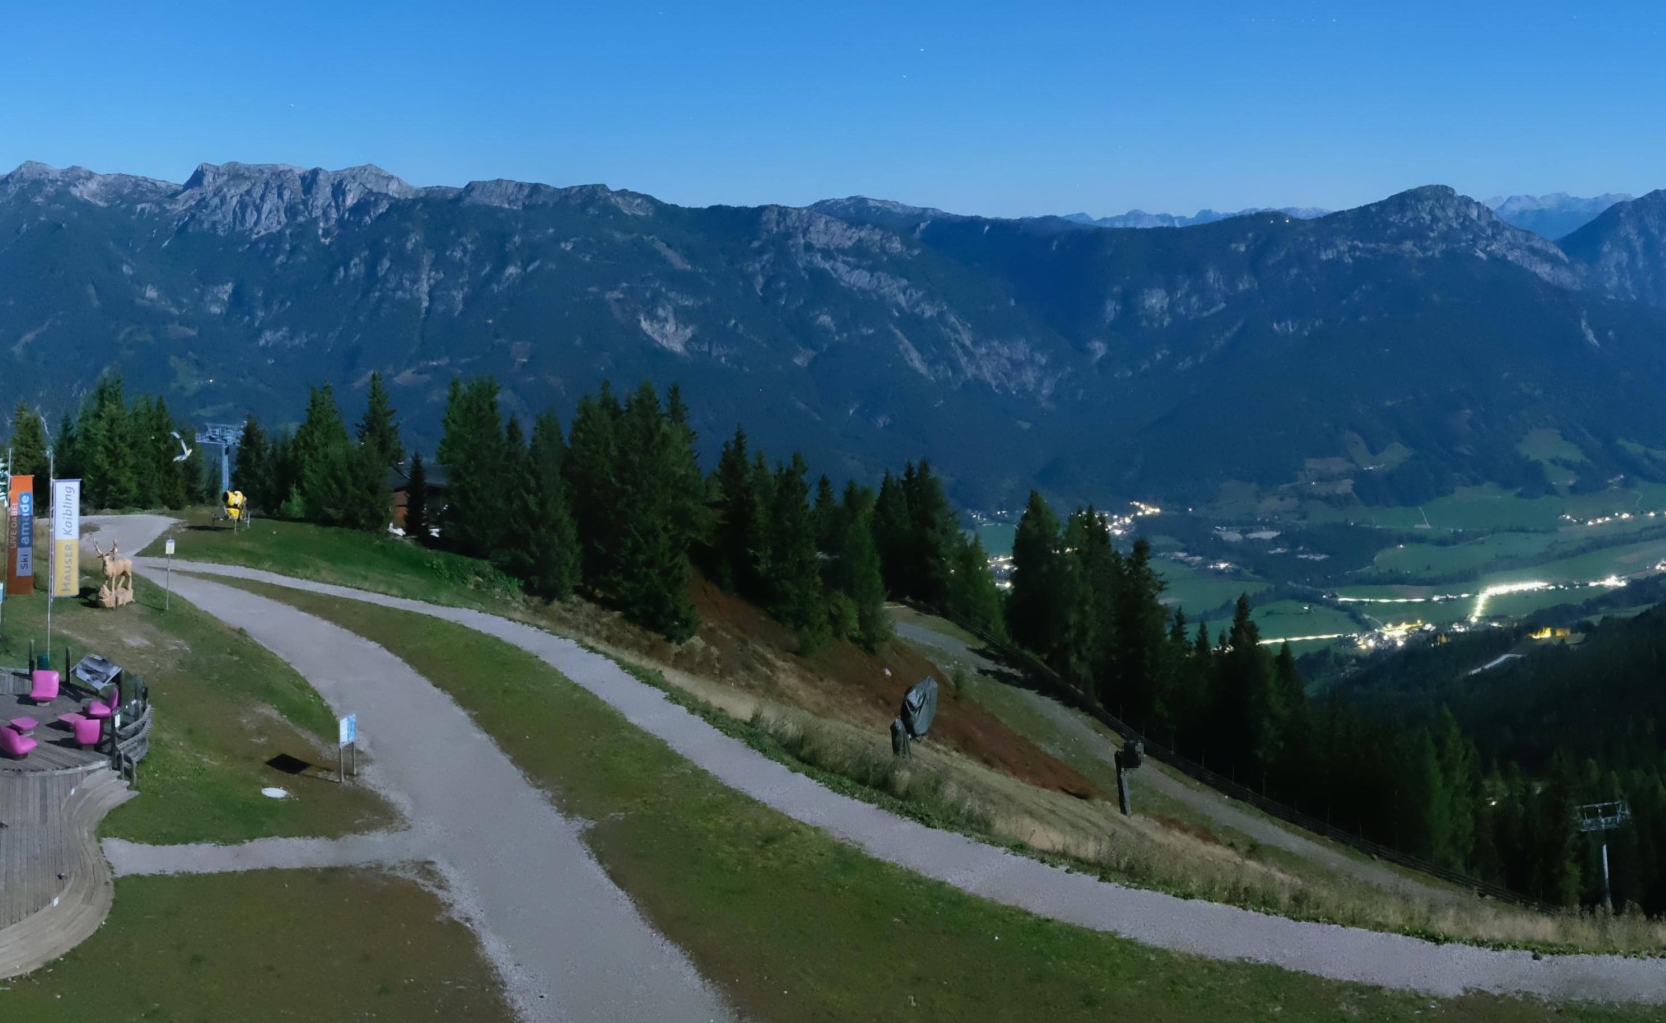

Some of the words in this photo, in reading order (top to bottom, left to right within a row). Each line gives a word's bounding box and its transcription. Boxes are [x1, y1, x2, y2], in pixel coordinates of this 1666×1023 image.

[62, 486, 76, 536] Kaibling
[20, 554, 29, 570] Ski
[61, 544, 72, 592] HAUSER
